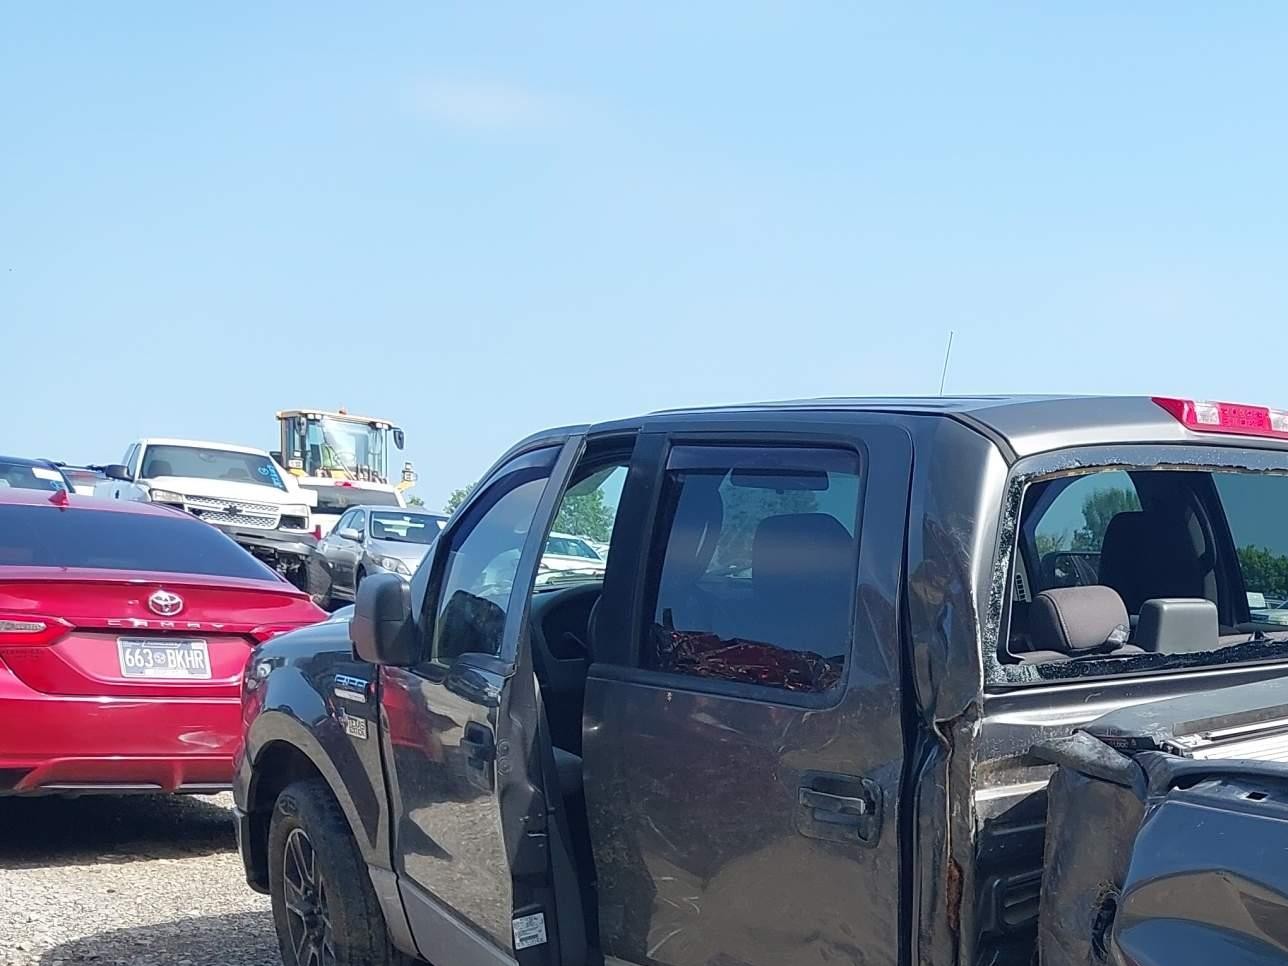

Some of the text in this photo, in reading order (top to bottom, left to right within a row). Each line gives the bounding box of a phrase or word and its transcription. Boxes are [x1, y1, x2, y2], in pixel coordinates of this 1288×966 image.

[107, 617, 225, 629] CAMRY
[125, 648, 205, 670] 663 BKHR
